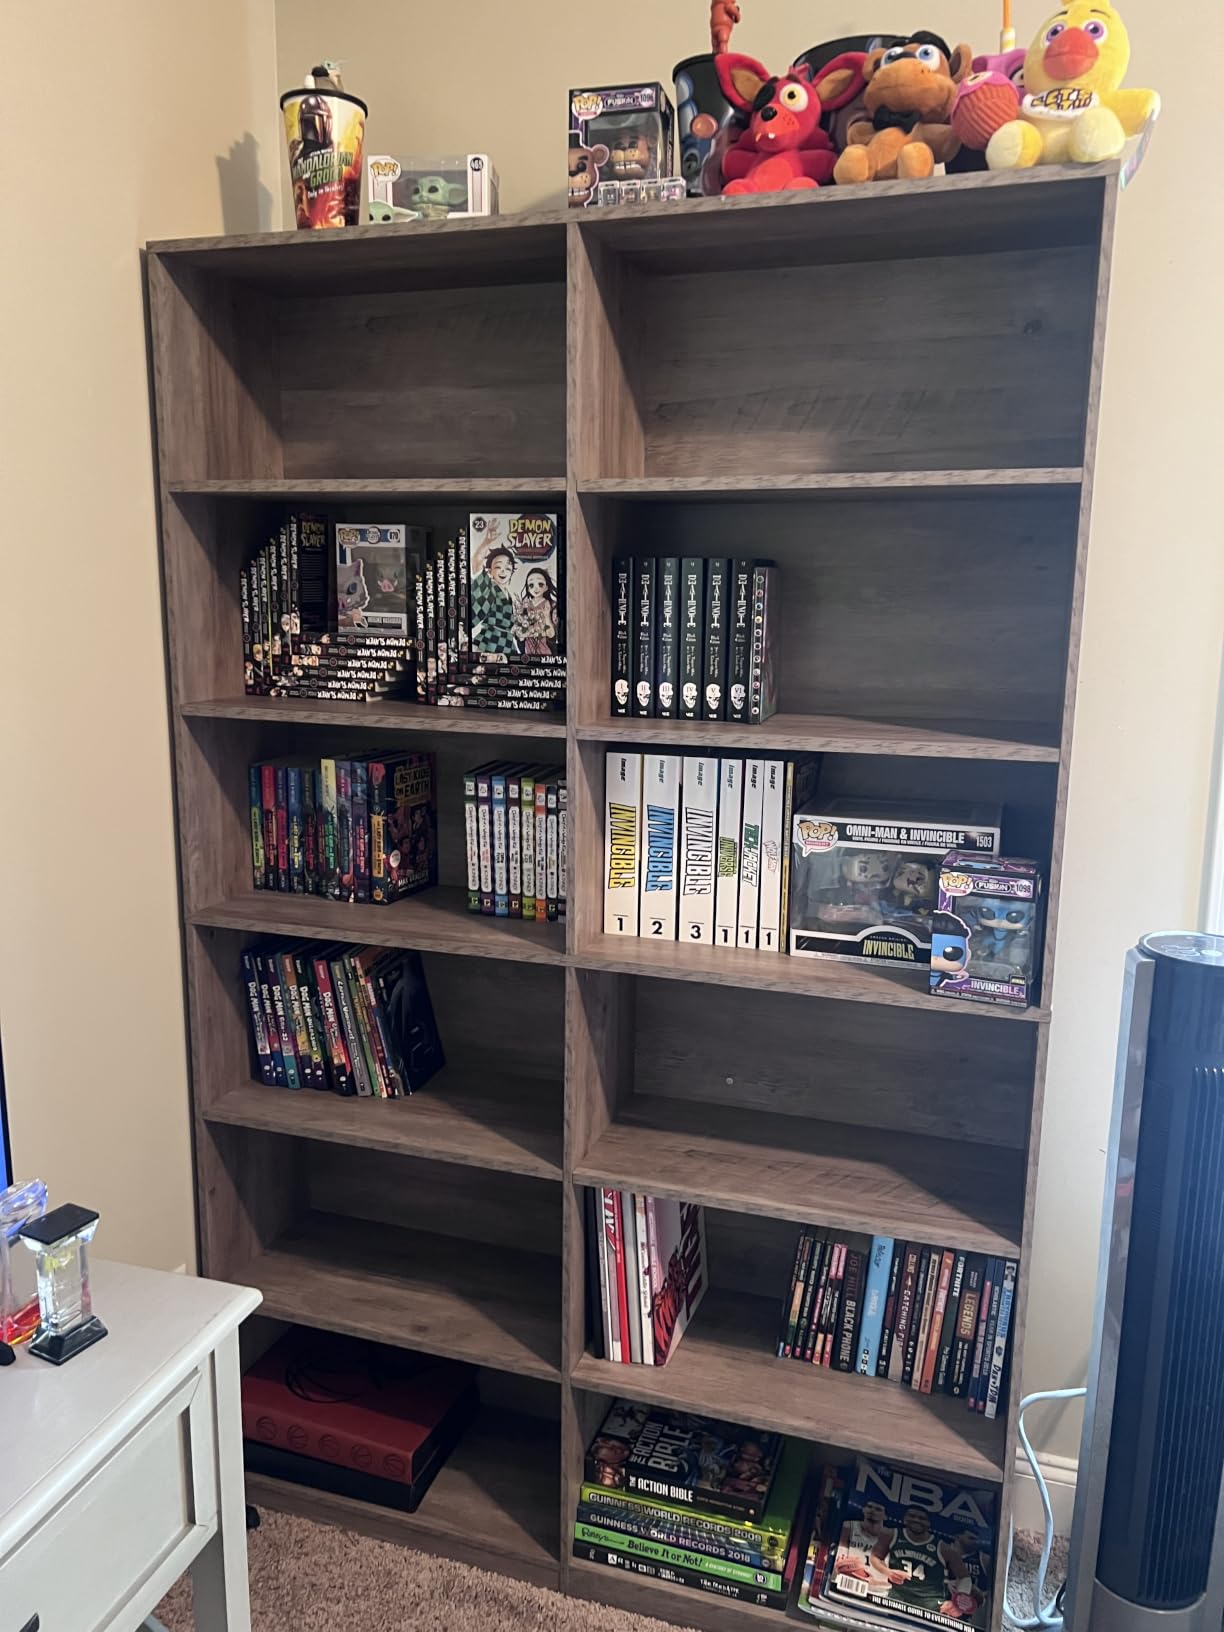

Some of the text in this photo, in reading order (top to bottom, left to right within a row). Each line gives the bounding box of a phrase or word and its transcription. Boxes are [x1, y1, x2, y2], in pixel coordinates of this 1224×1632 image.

[369, 162, 399, 177] POP!
[475, 520, 484, 529] 23
[509, 519, 552, 533] DEMON
[508, 533, 553, 548] SLAYER
[366, 637, 406, 647] DEMON SLAYER
[357, 649, 377, 657] SLAYER
[541, 656, 562, 664] SLAYER
[348, 660, 387, 669] DEMON SLAYER
[337, 670, 376, 679] DEMON SLAYER
[531, 668, 552, 677] SLAYER
[328, 681, 367, 690] DEMON SLAYER
[519, 679, 561, 688] DEMON SLAYER
[318, 691, 356, 700] DEMON SLAYER
[507, 690, 550, 699] DEMON SLAYER
[497, 700, 540, 710] DEMON SLAYER
[799, 822, 837, 840] POP!
[846, 825, 965, 843] OMNI-MAN & INVINCIBLE
[608, 802, 637, 889] INVINCIBLE
[645, 804, 675, 892] INVINCIBLE
[976, 836, 992, 847] 1503
[683, 807, 713, 896] INVINCIBLE
[742, 848, 758, 887] JACKET
[941, 875, 972, 888] POP!
[1016, 884, 1031, 892] 1098
[617, 918, 624, 931] 1
[651, 921, 663, 935] 2
[690, 925, 702, 939] 3
[722, 929, 728, 943] 1
[744, 930, 749, 943] 1
[766, 932, 772, 945] 1
[863, 940, 914, 960] INVINCIBLE
[300, 986, 309, 1001] DOG
[971, 981, 1019, 993] INVINCIBLE
[248, 981, 260, 1012] DOG MAN
[261, 984, 272, 1014] DOG MAN
[272, 985, 284, 1016] DOG MAN
[289, 985, 300, 1015] DOG MAN
[323, 992, 333, 1007] DOG
[302, 1001, 312, 1016] MAN
[325, 1007, 335, 1022] MAN
[953, 1256, 965, 1297] FORTNITE
[843, 1300, 856, 1329] BLACK
[898, 1290, 911, 1330] CATCHING
[960, 1293, 976, 1336] LEGENDS
[840, 1331, 853, 1362] PHONE
[636, 1423, 664, 1456] ACTION
[649, 1424, 693, 1473] BIBLE
[638, 1478, 669, 1496] ACTION
[670, 1486, 693, 1502] BIBLE
[855, 1456, 989, 1529] NBA
[589, 1493, 642, 1514] GUINNESS
[643, 1504, 681, 1522] WORLD
[682, 1515, 731, 1535] RECORDS
[590, 1514, 750, 1563] GUINNESS WORLD RECORDS 2018
[627, 1540, 660, 1557] Believe
[661, 1549, 670, 1560] It
[672, 1553, 681, 1561] or
[683, 1555, 703, 1567] Not!
[901, 1559, 926, 1580] 34
[872, 1595, 880, 1603] THE
[881, 1598, 907, 1613] ULTIMATE
[908, 1606, 924, 1617] GUIDE
[925, 1611, 931, 1619] TO
[931, 1613, 963, 1630] EVERYTHING
